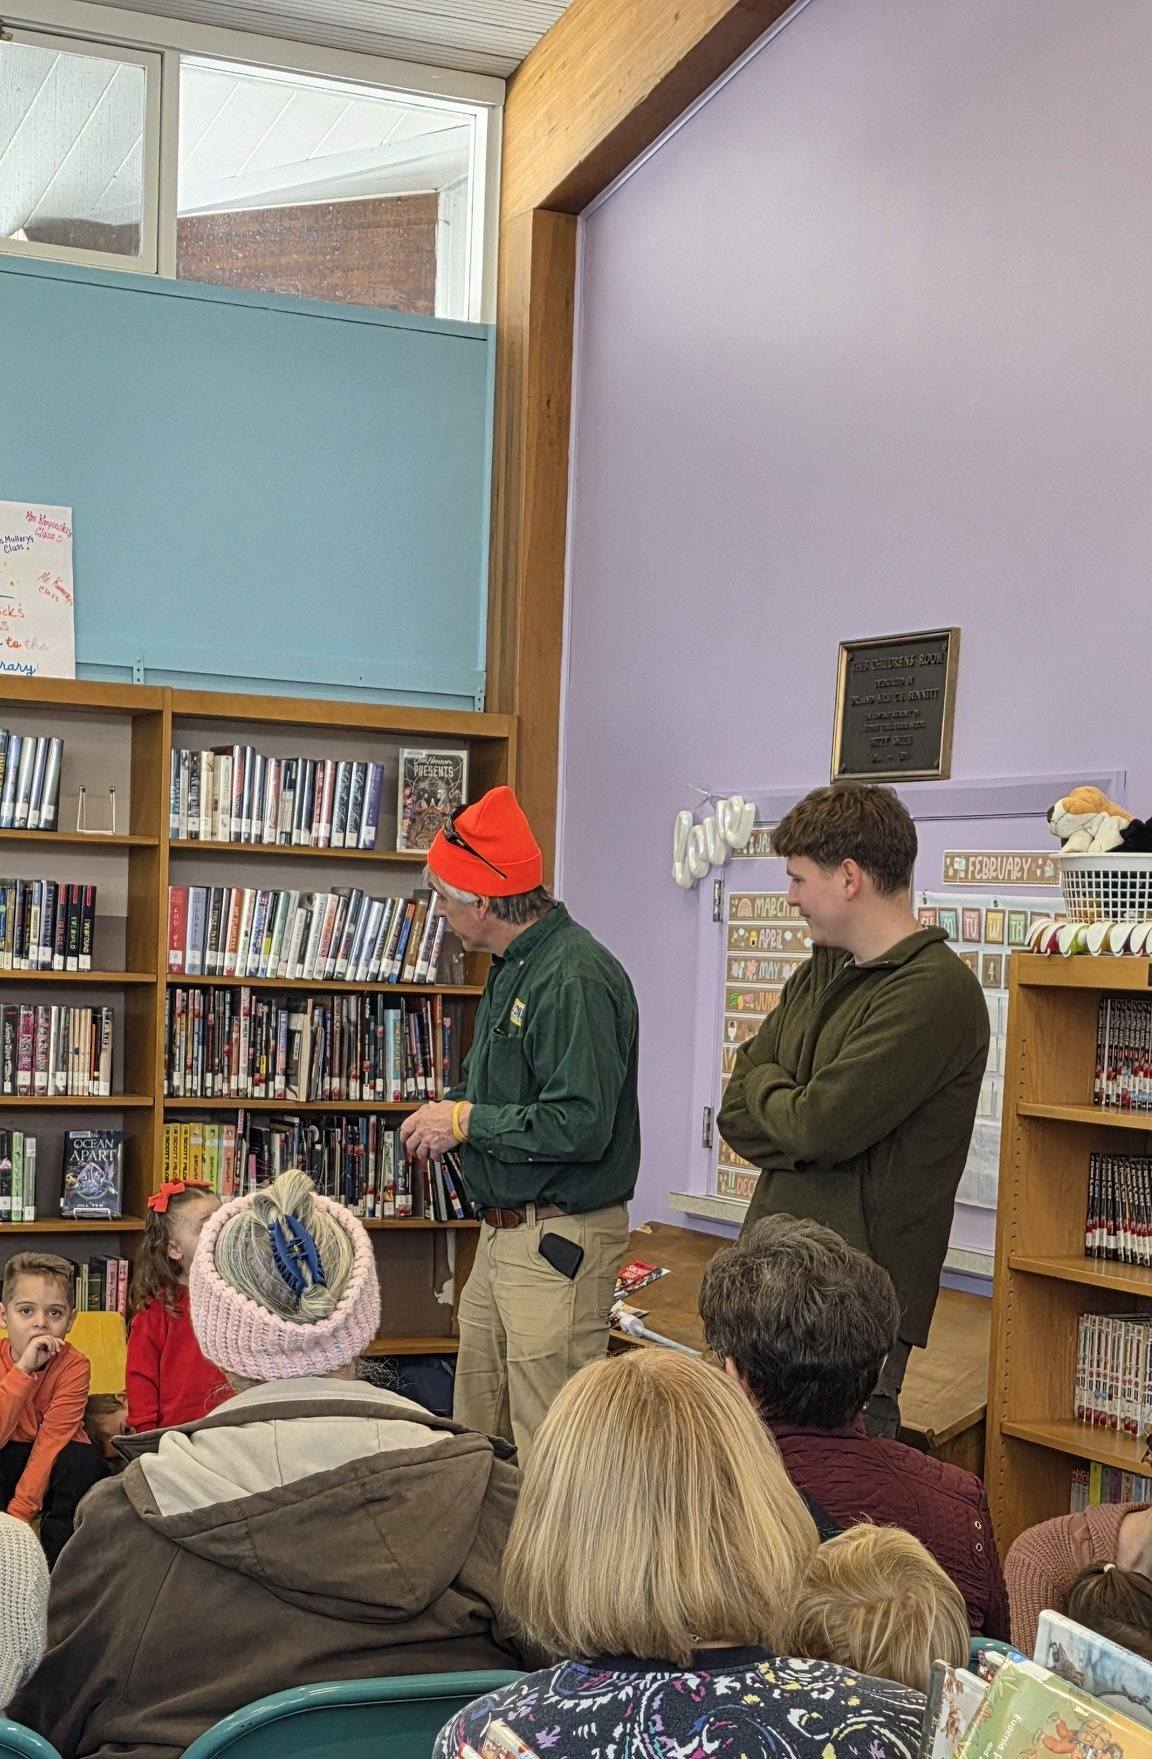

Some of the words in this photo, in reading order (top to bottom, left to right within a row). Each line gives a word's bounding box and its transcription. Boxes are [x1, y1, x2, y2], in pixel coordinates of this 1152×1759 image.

[5, 636, 22, 649] to
[24, 636, 49, 651] the
[414, 765, 454, 777] PRESENTS
[968, 856, 1032, 881] FEBRUARY
[755, 897, 790, 917] MARCH
[965, 918, 980, 939] TU
[989, 919, 1001, 938] W
[758, 928, 783, 949] APRIL
[759, 961, 780, 979] MAY
[988, 962, 995, 981] 4
[73, 1138, 114, 1149] OCEAN
[70, 1149, 116, 1161] APART
[997, 1713, 1022, 1751] Eugenia
[983, 1741, 994, 1758] and
